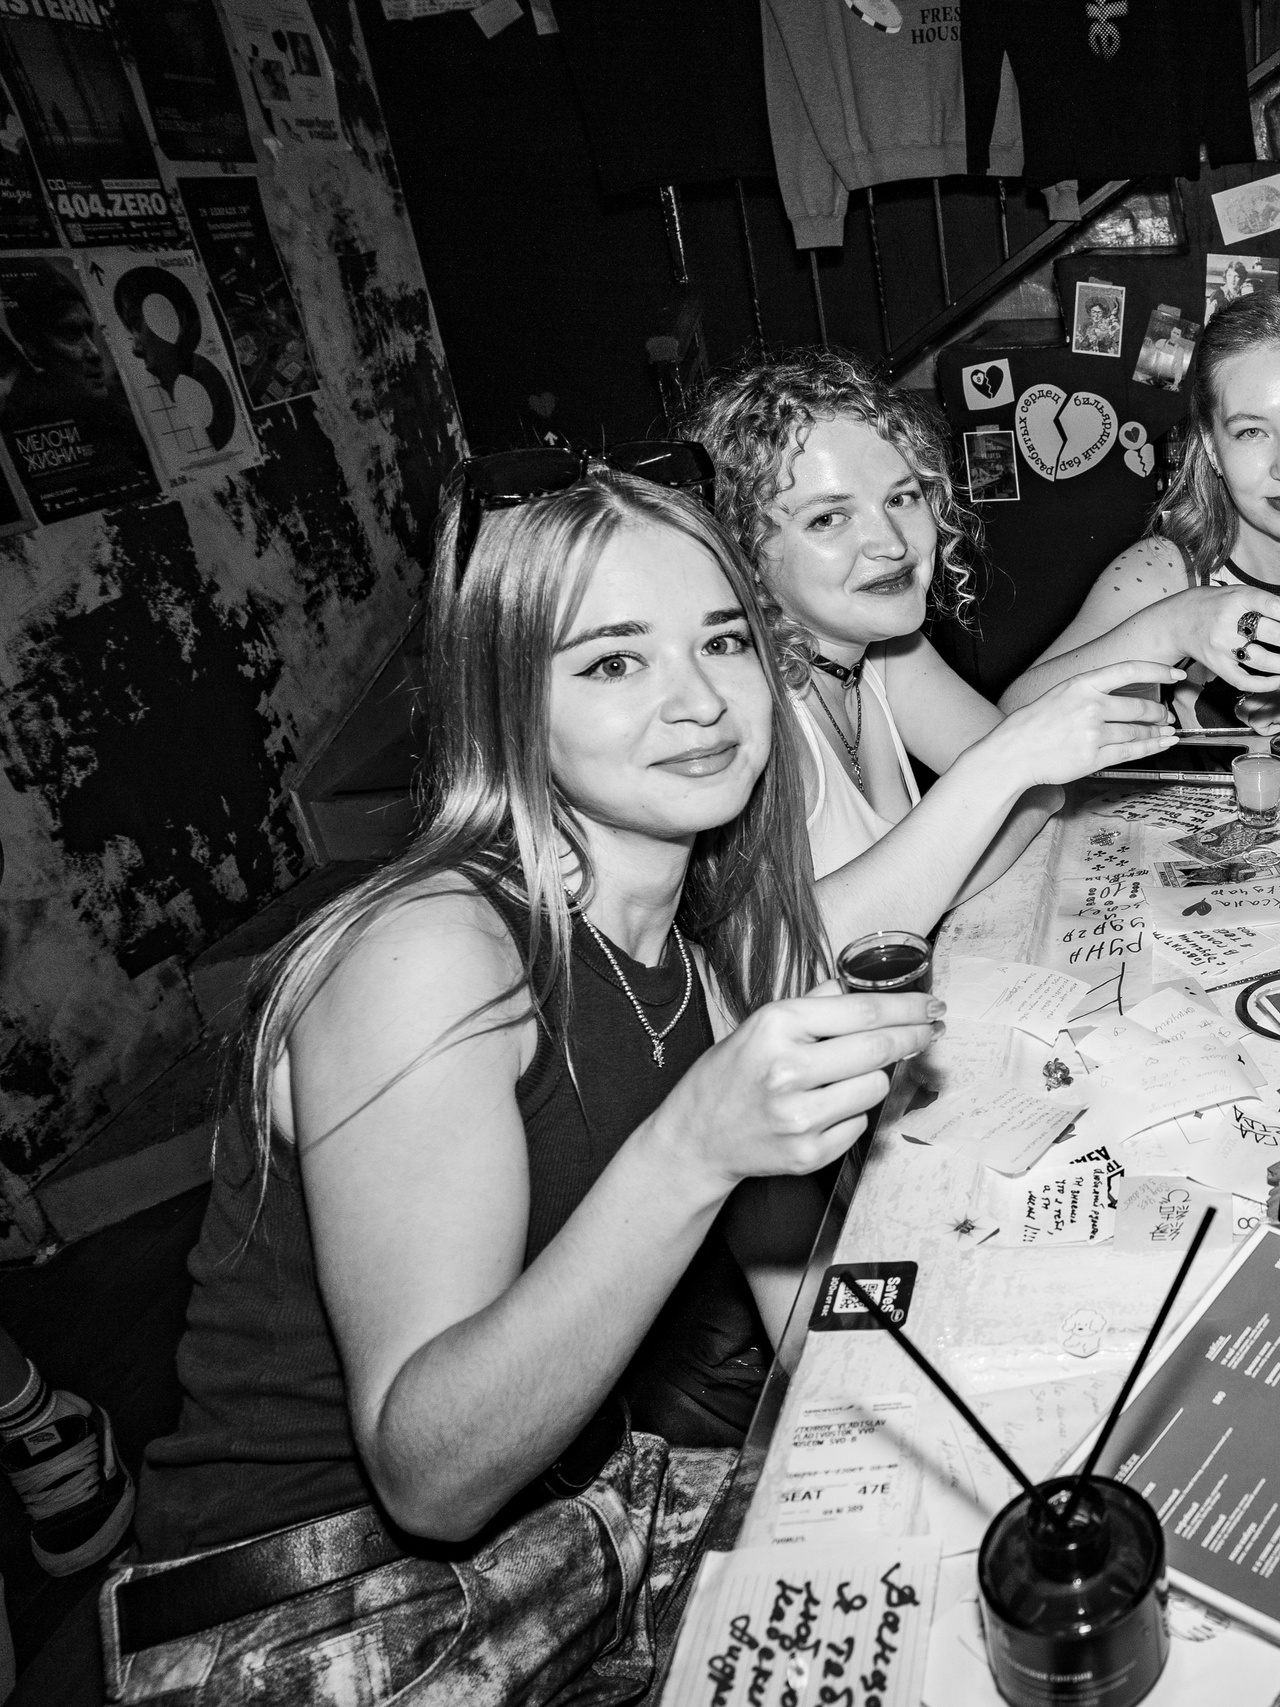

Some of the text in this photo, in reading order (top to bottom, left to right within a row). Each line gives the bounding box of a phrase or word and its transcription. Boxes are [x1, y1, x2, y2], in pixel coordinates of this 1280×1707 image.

[920, 6, 962, 24] FRES
[911, 25, 962, 44] HOUS
[56, 192, 169, 220] 404.ZERO
[15, 425, 82, 455] МЕЛОЧИ
[1018, 388, 1062, 477] разбитых сердец
[1060, 394, 1112, 473] бильярдный бар
[22, 446, 78, 473] ЖИЗНИ
[881, 1276, 902, 1313] SaYeS
[780, 1482, 892, 1501] SEAT 47E
[816, 1636, 856, 1707] Теб
